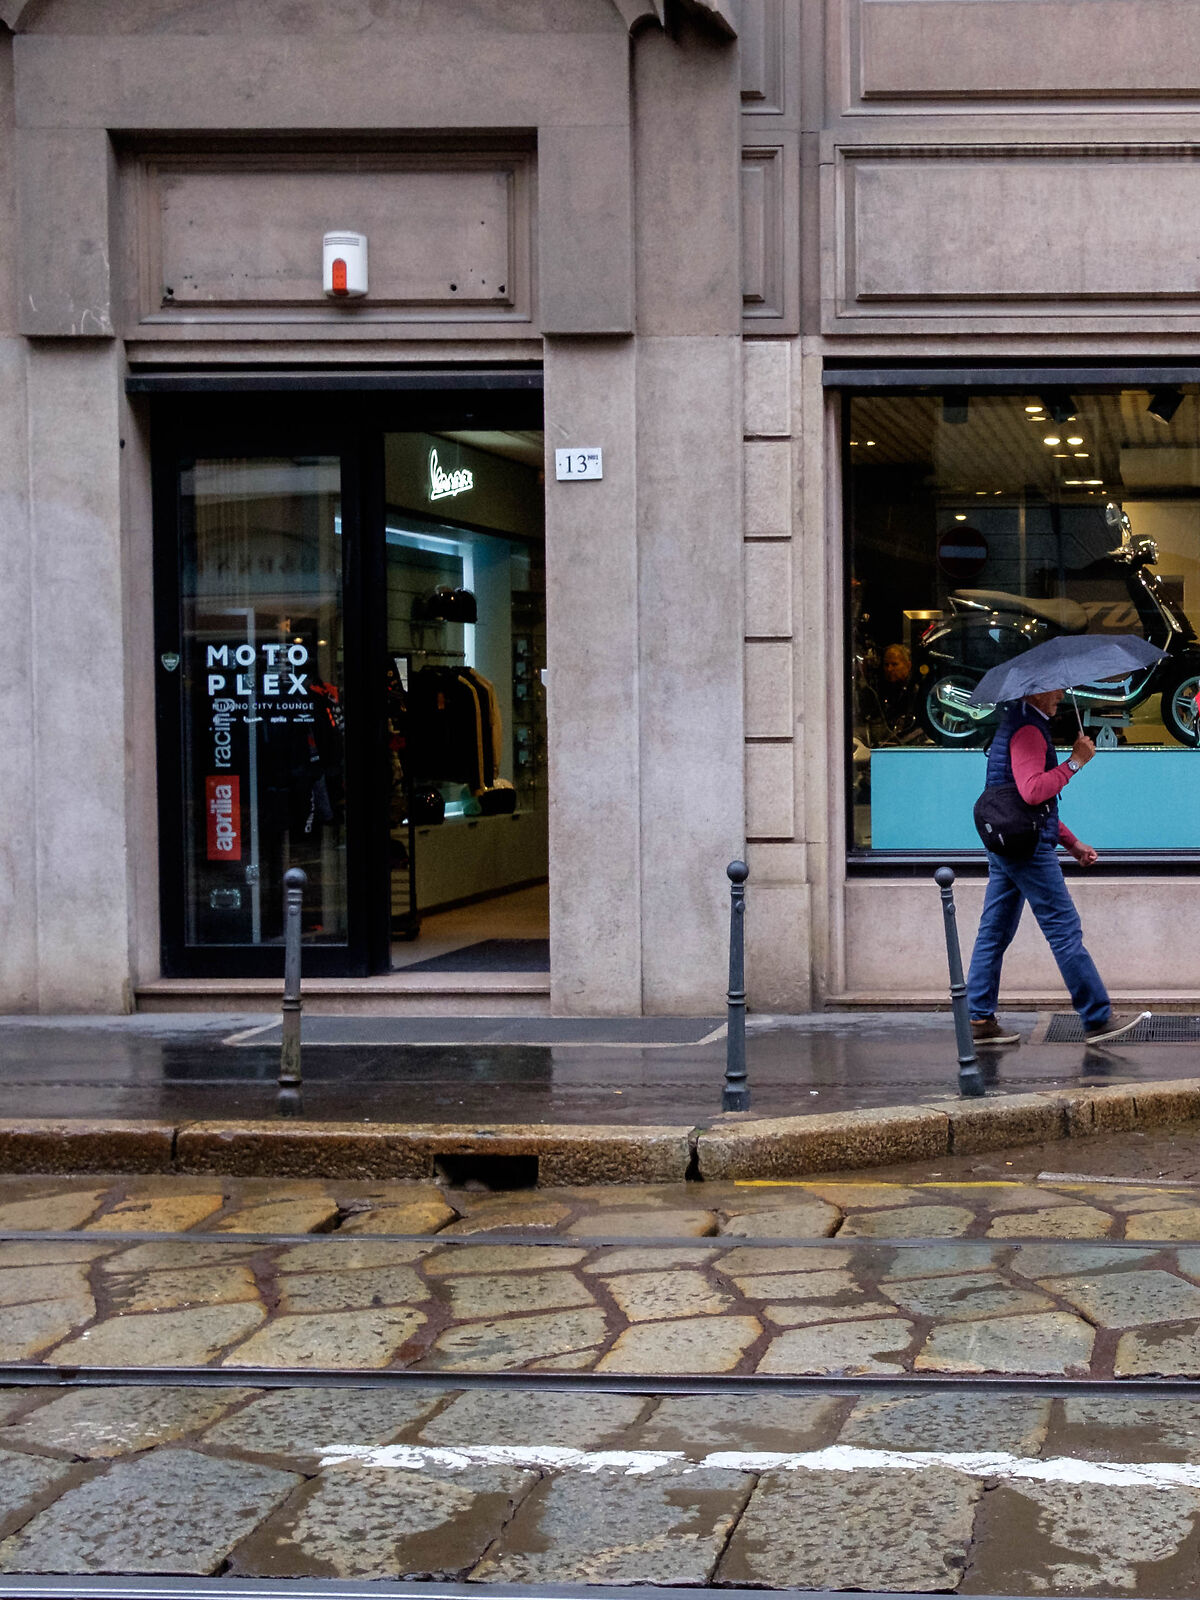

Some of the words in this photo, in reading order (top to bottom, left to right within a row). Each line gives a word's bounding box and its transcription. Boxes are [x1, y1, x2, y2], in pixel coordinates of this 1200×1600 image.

[566, 455, 587, 473] 13
[206, 644, 308, 667] MOTO
[208, 674, 308, 696] PLEX
[209, 698, 236, 768] racing
[210, 784, 236, 851] aprilia
